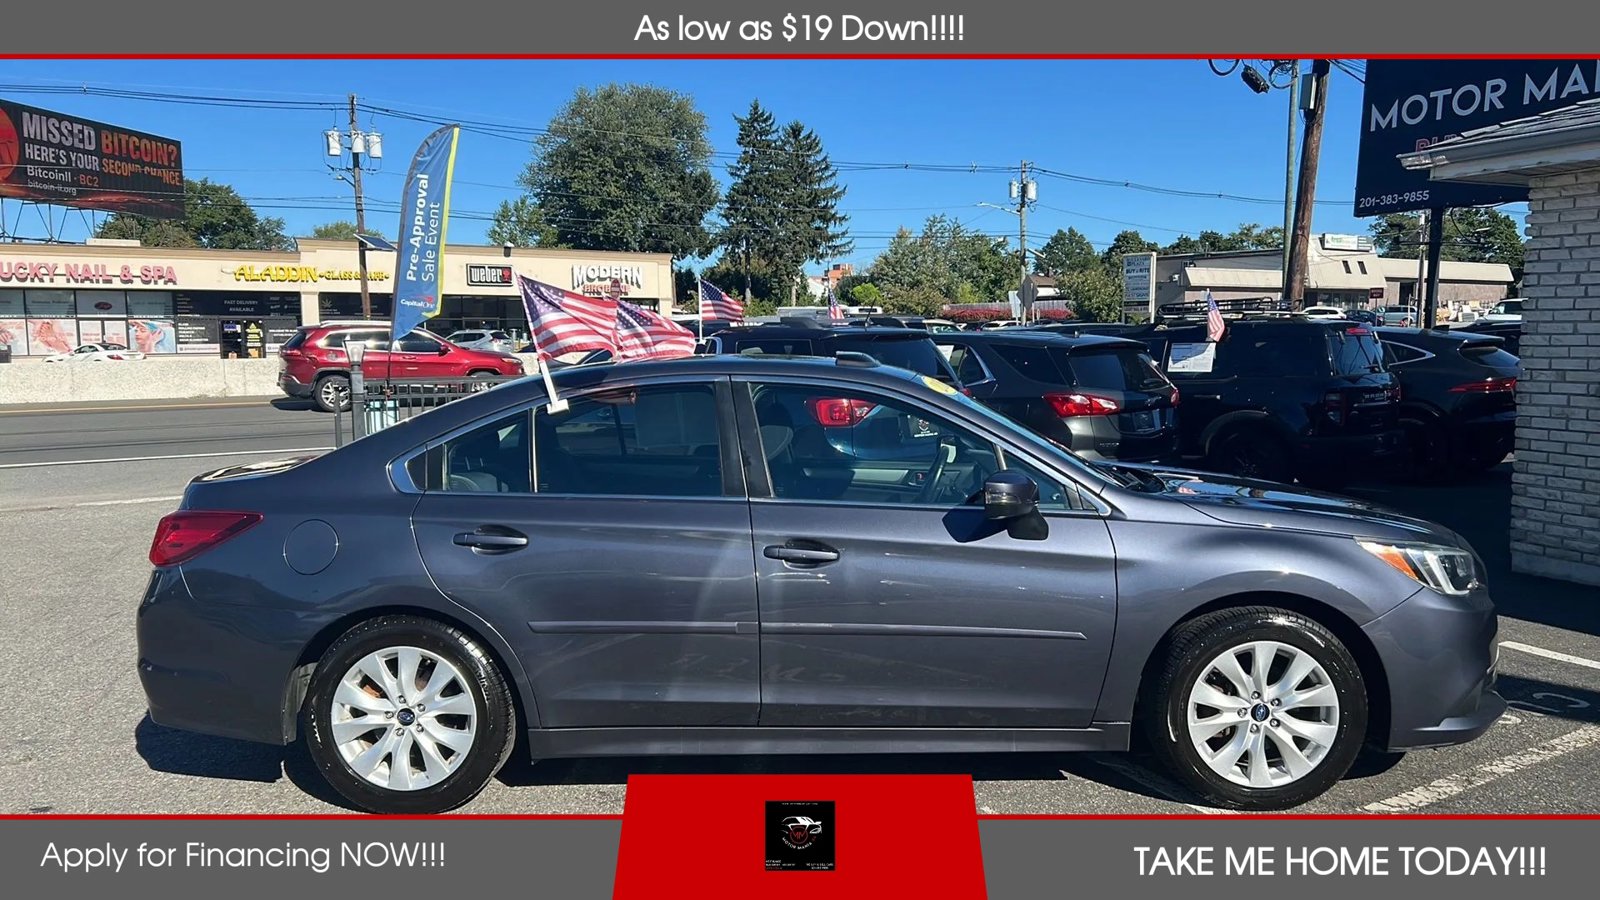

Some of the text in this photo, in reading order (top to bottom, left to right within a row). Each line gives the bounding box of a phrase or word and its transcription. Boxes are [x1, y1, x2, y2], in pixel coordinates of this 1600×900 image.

[1370, 58, 1600, 132] MOTOR MA
[21, 111, 178, 167] MISSED BITCOIN?
[24, 143, 68, 167] HERE'S
[70, 151, 100, 172] YOUR
[79, 173, 99, 188] BC2
[1359, 190, 1430, 209] 201-383-9855
[406, 173, 429, 282] Pre-Approval
[421, 202, 441, 283] Sale Event
[64, 263, 113, 284] NAIL
[119, 264, 134, 285] &
[140, 265, 178, 286] SPA
[235, 264, 319, 283] ALADDIN
[470, 265, 502, 284] weber
[571, 264, 643, 290] MODERN
